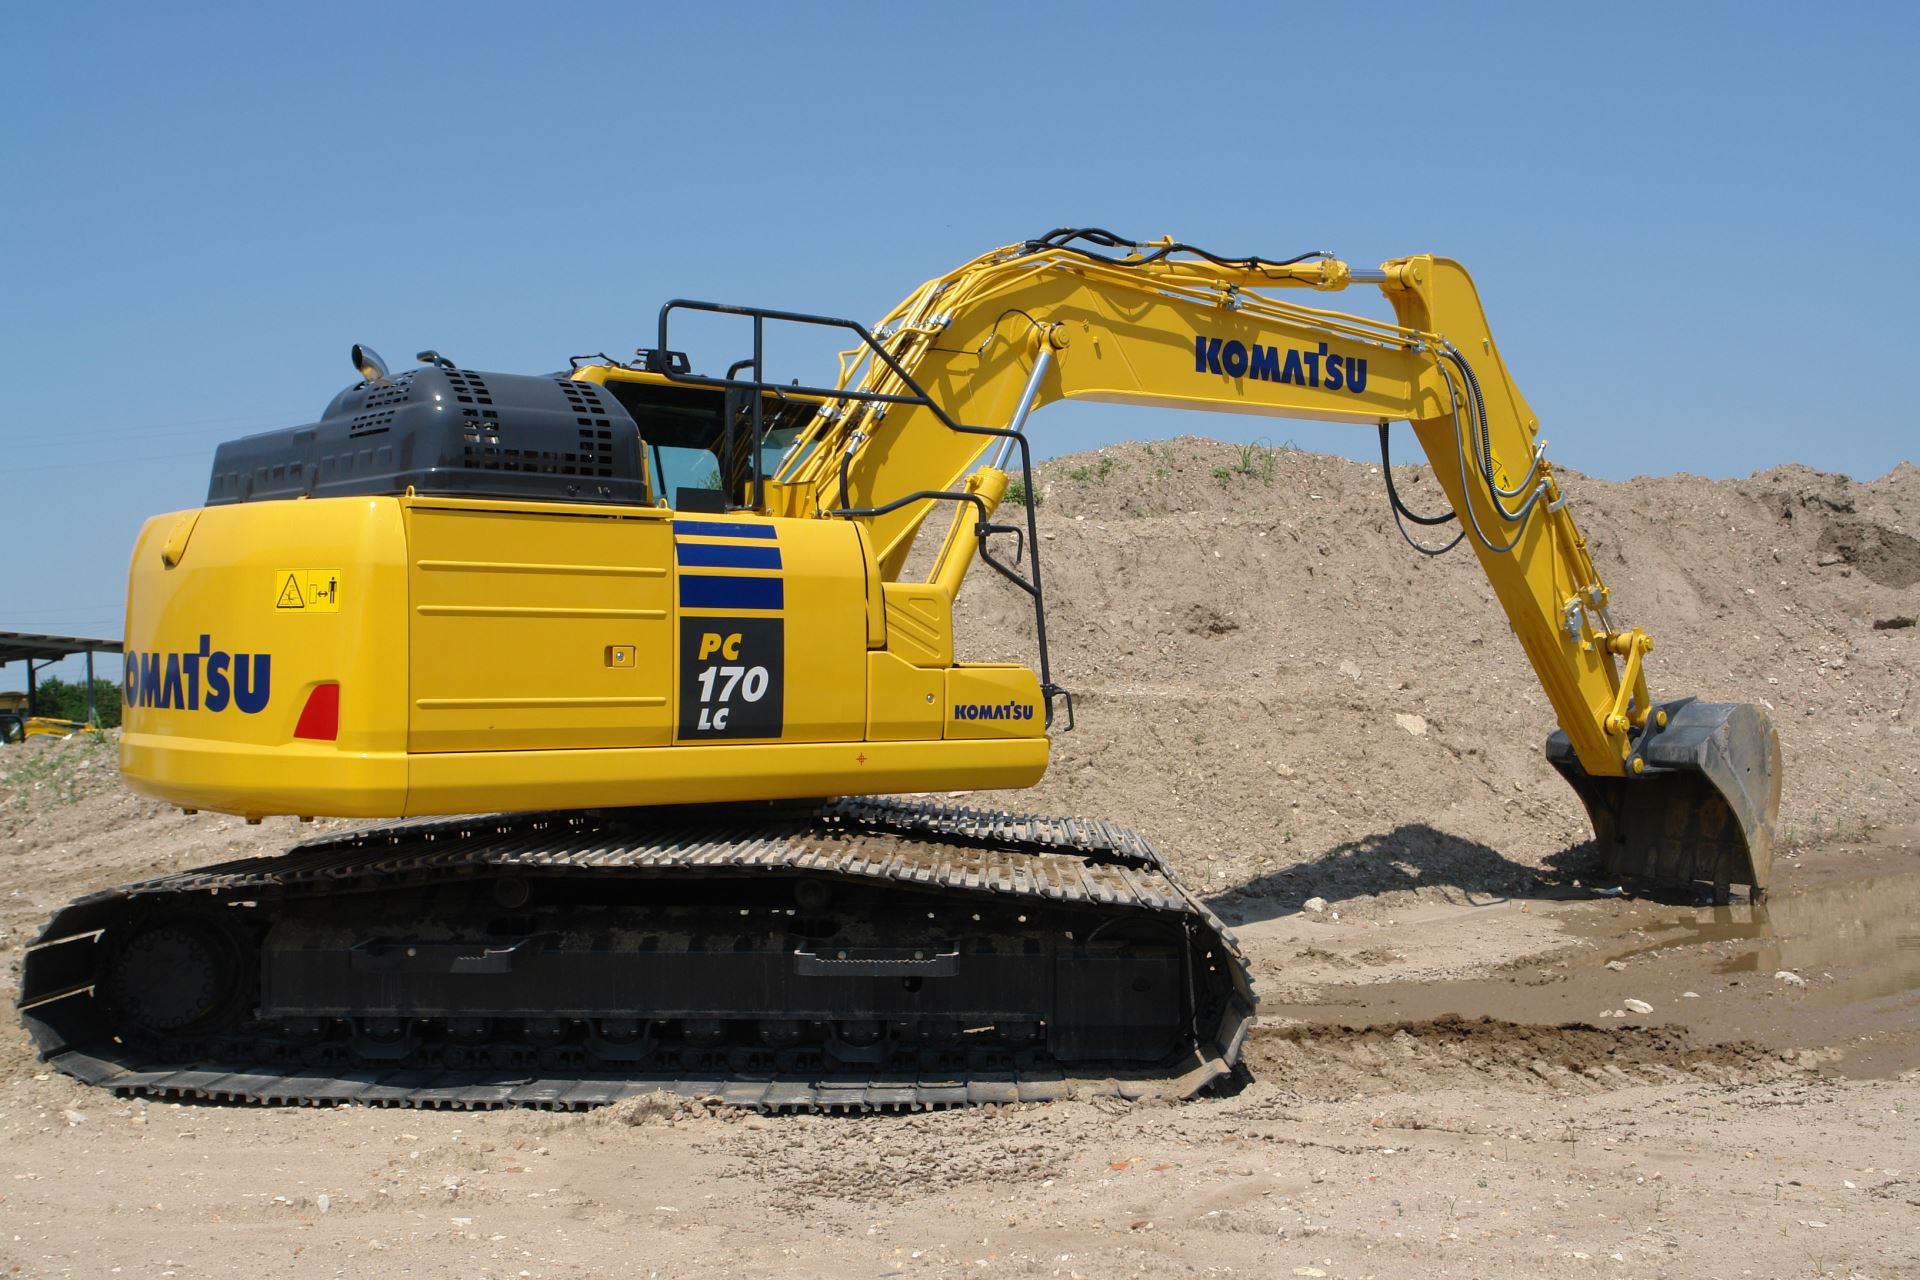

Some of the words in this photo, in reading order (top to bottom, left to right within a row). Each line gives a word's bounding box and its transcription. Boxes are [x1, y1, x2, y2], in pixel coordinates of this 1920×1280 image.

[1195, 336, 1368, 394] KOMATSU
[698, 632, 743, 661] PC
[123, 634, 272, 714] OMATSU
[698, 665, 769, 703] 170
[697, 707, 730, 730] LC
[954, 700, 1034, 720] KOMATSU
